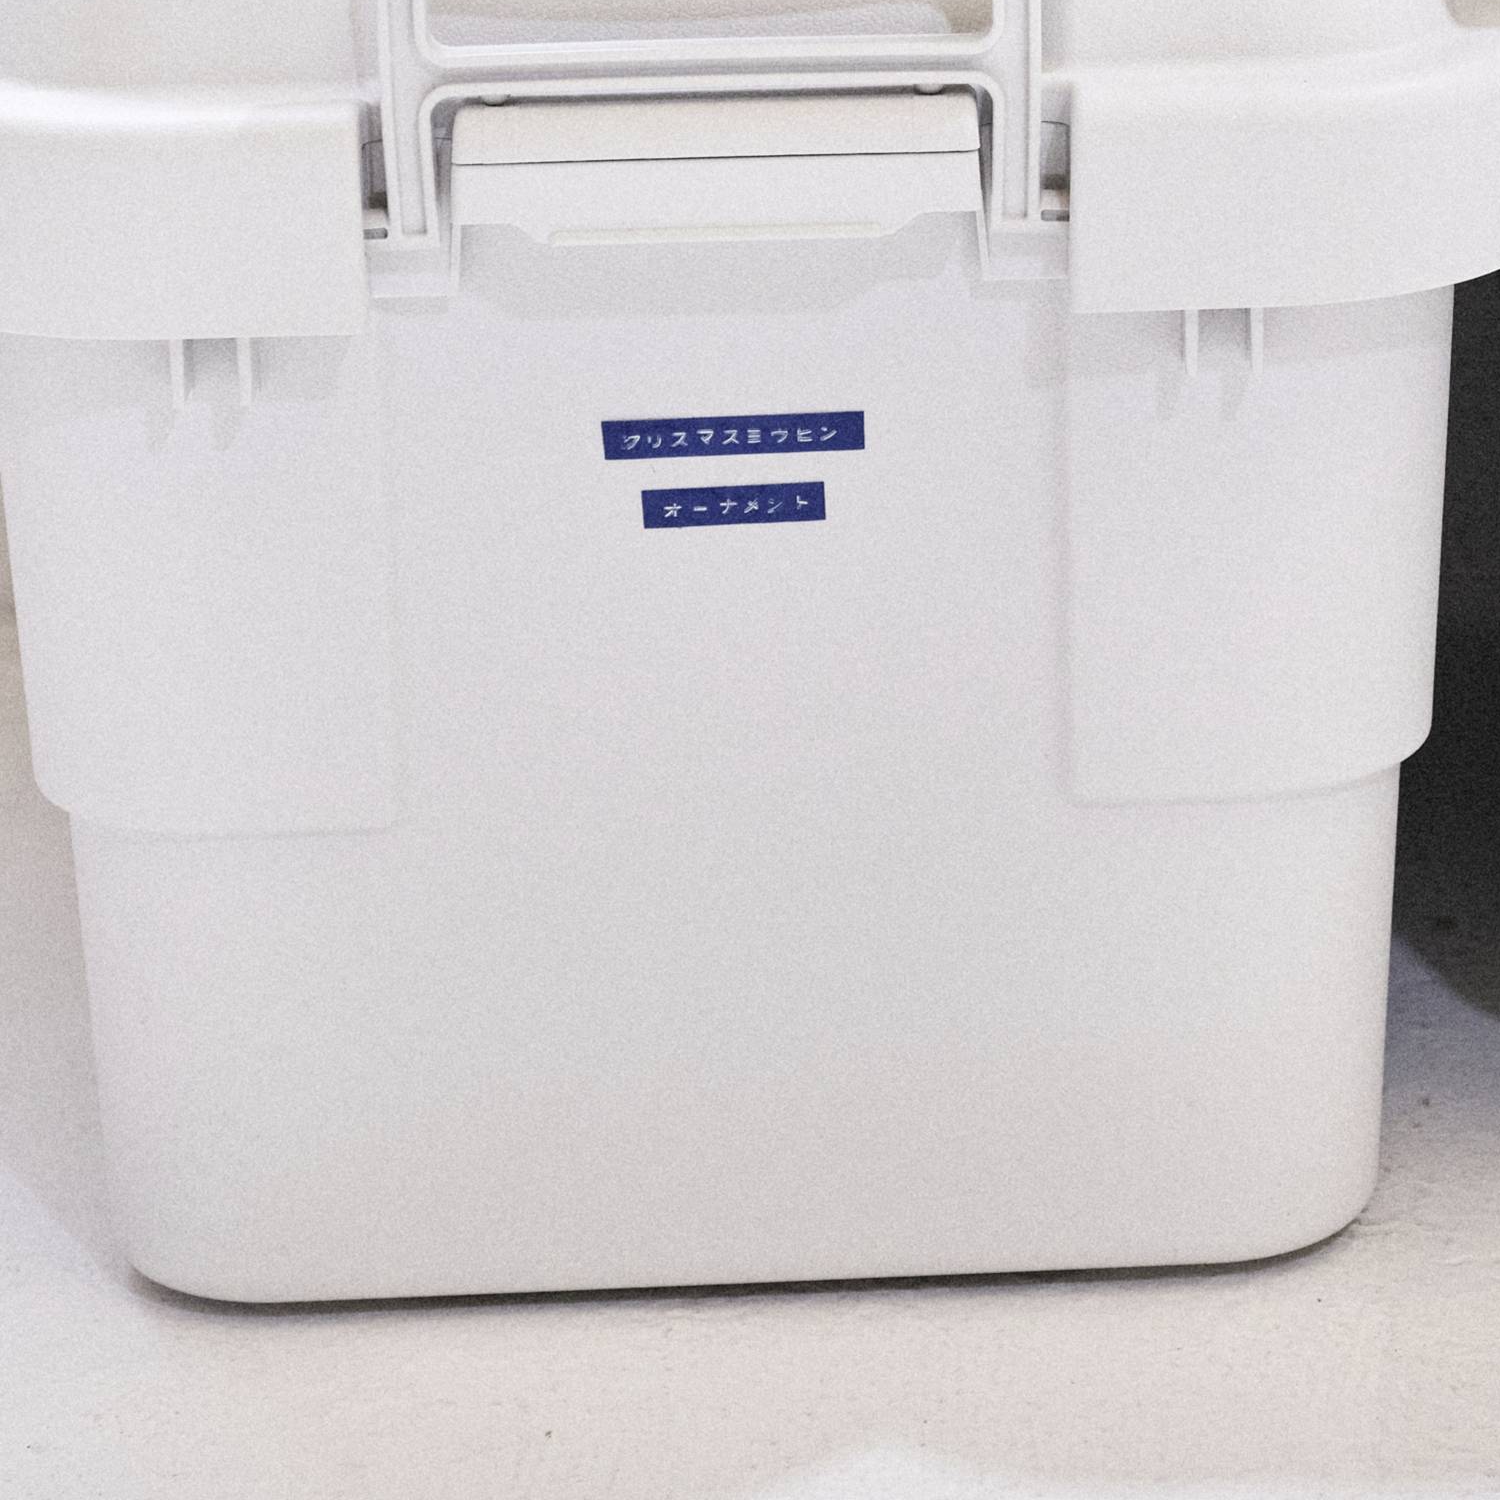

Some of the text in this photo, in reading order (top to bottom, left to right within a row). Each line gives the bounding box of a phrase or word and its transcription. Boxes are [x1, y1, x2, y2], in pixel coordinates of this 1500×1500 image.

[663, 494, 809, 518] オーナメント
